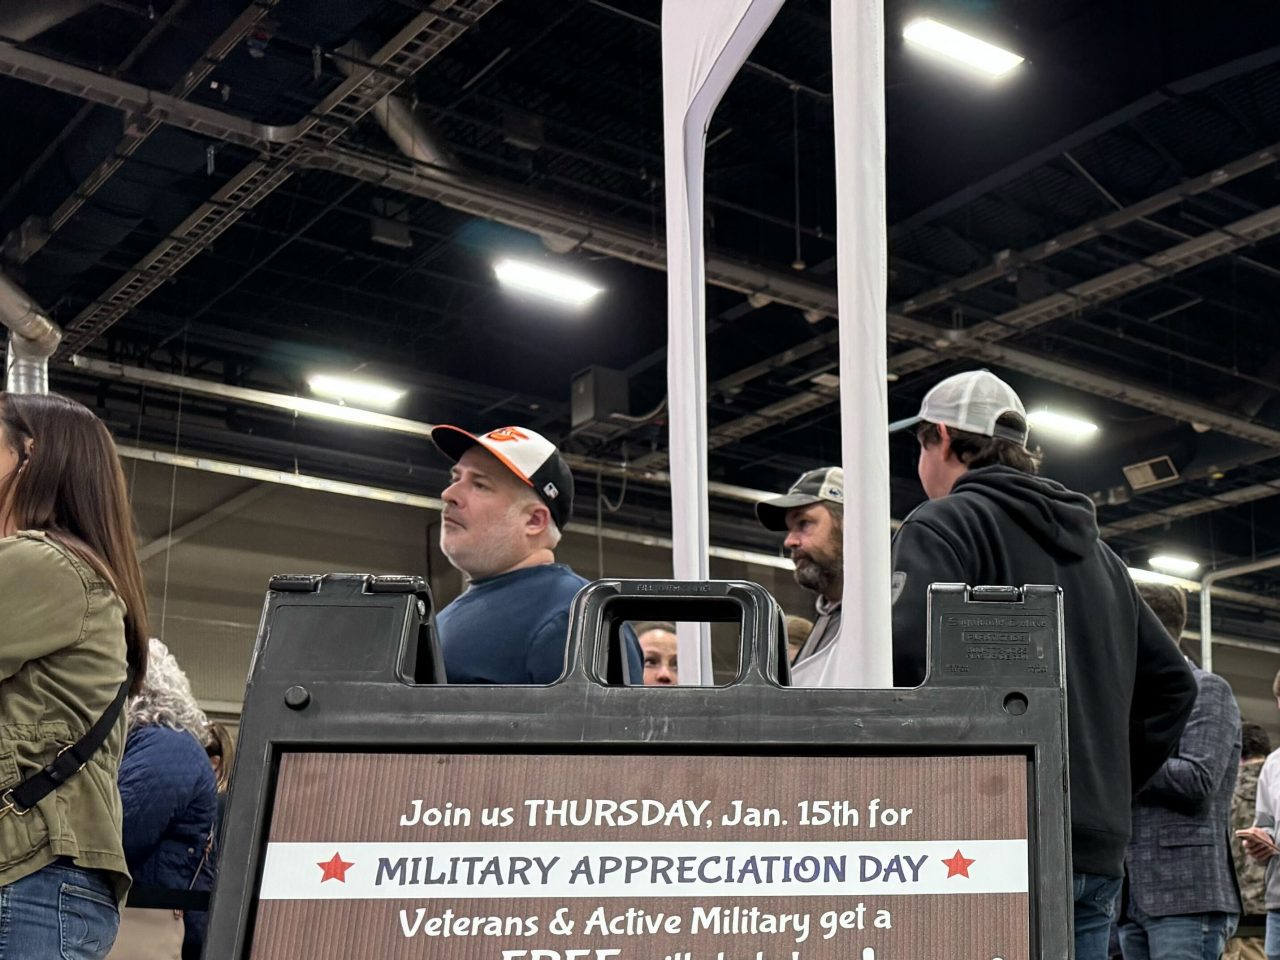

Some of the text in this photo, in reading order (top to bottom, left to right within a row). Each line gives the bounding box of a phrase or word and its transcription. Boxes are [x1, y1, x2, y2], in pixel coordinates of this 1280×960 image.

[400, 798, 913, 830] Join us THURSDAY, Jan. 15th for
[376, 854, 929, 887] MILITARY APPRECIATION DAY
[399, 903, 892, 942] Veterans & Active Military get a
